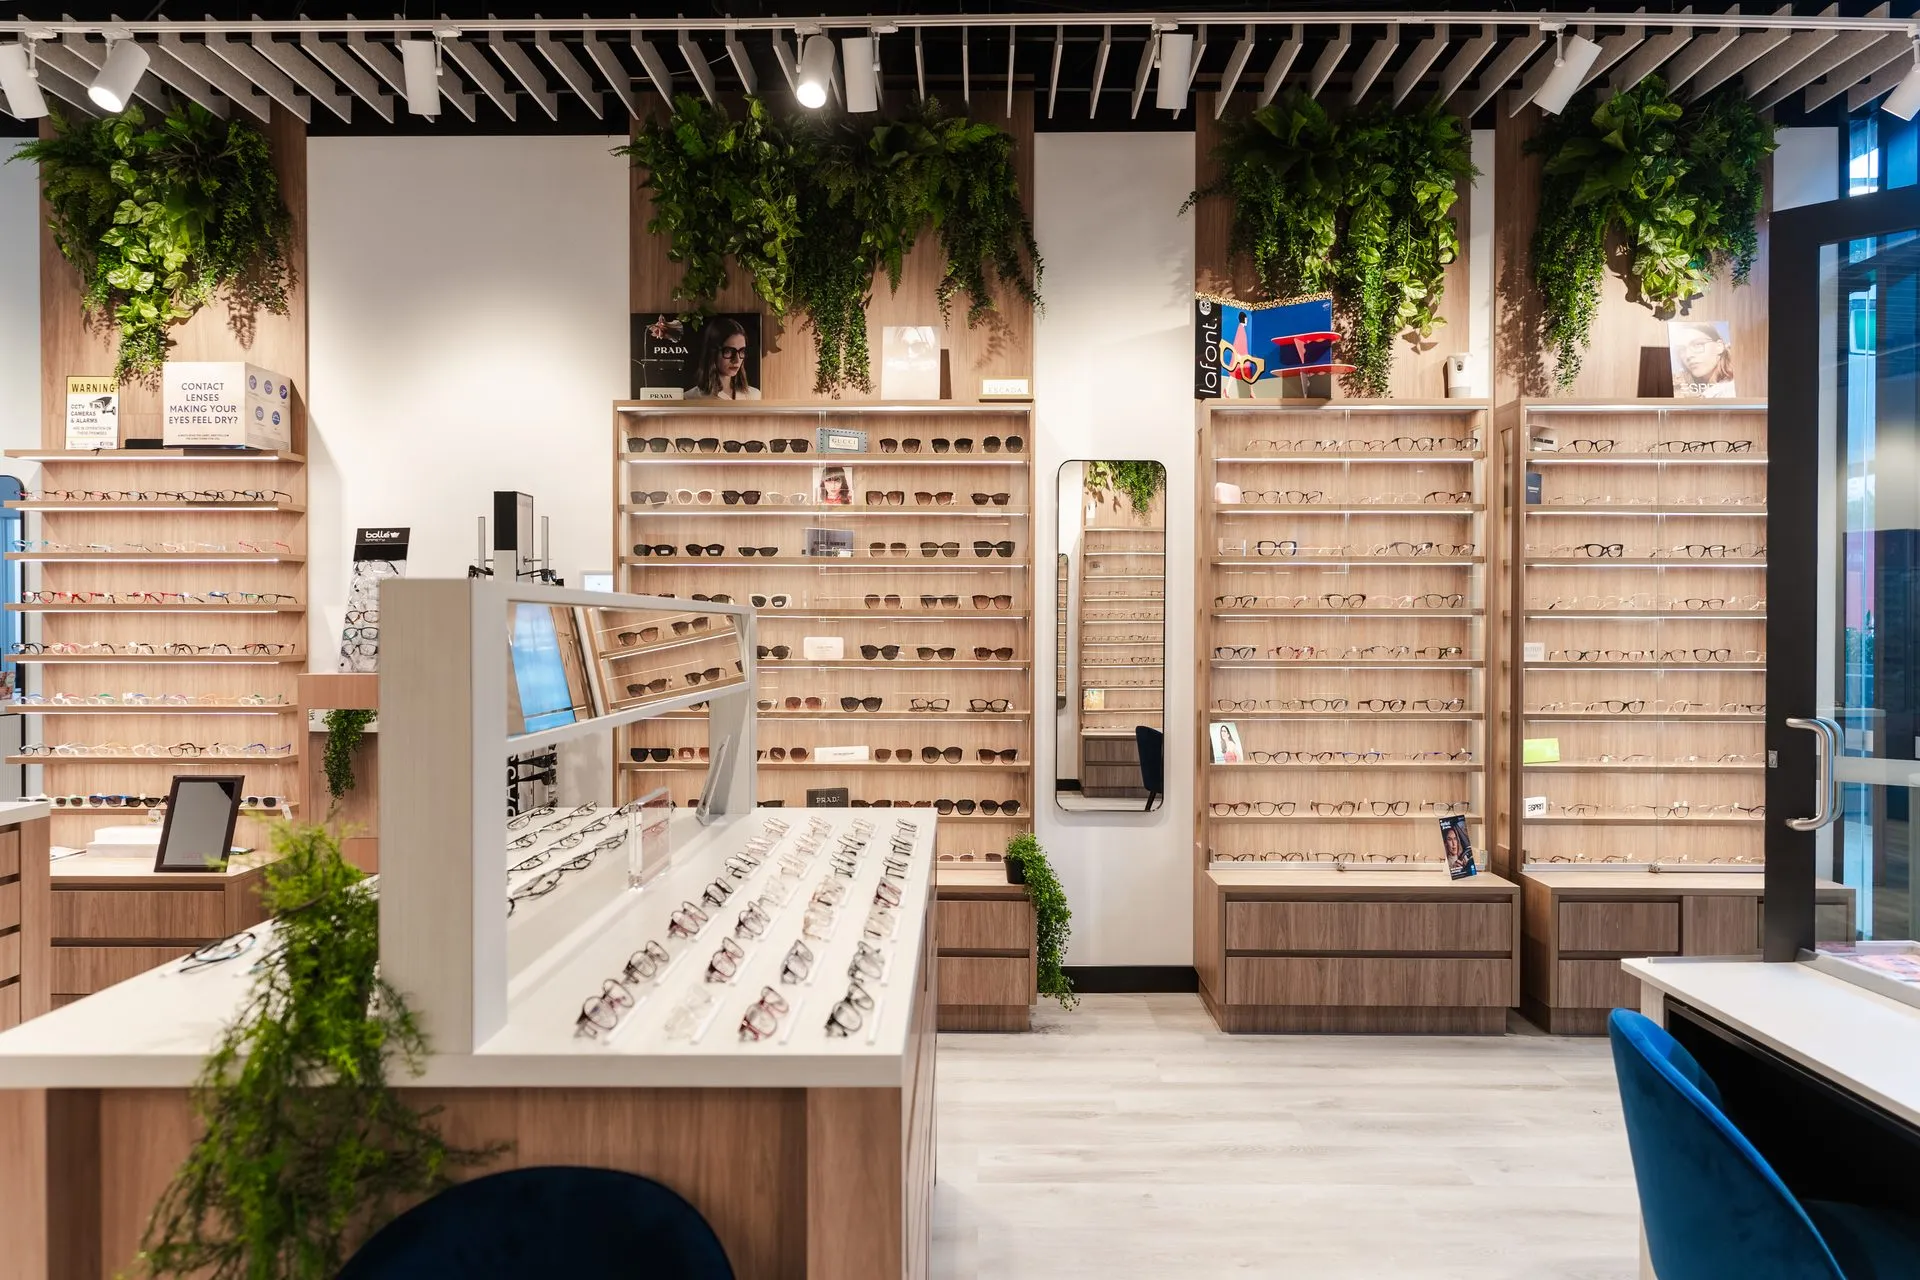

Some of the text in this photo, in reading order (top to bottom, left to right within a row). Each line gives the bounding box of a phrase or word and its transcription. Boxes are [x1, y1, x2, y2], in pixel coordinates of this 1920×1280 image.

[653, 346, 689, 354] PRADA
[1199, 318, 1218, 394] lafont.
[71, 383, 115, 393] WARNING
[181, 382, 225, 391] CONTACT
[185, 393, 220, 402] LENSES
[169, 404, 237, 413] MAKING YOUR
[168, 415, 238, 424] EYES FEEL DRY?
[365, 530, 390, 539] bollé
